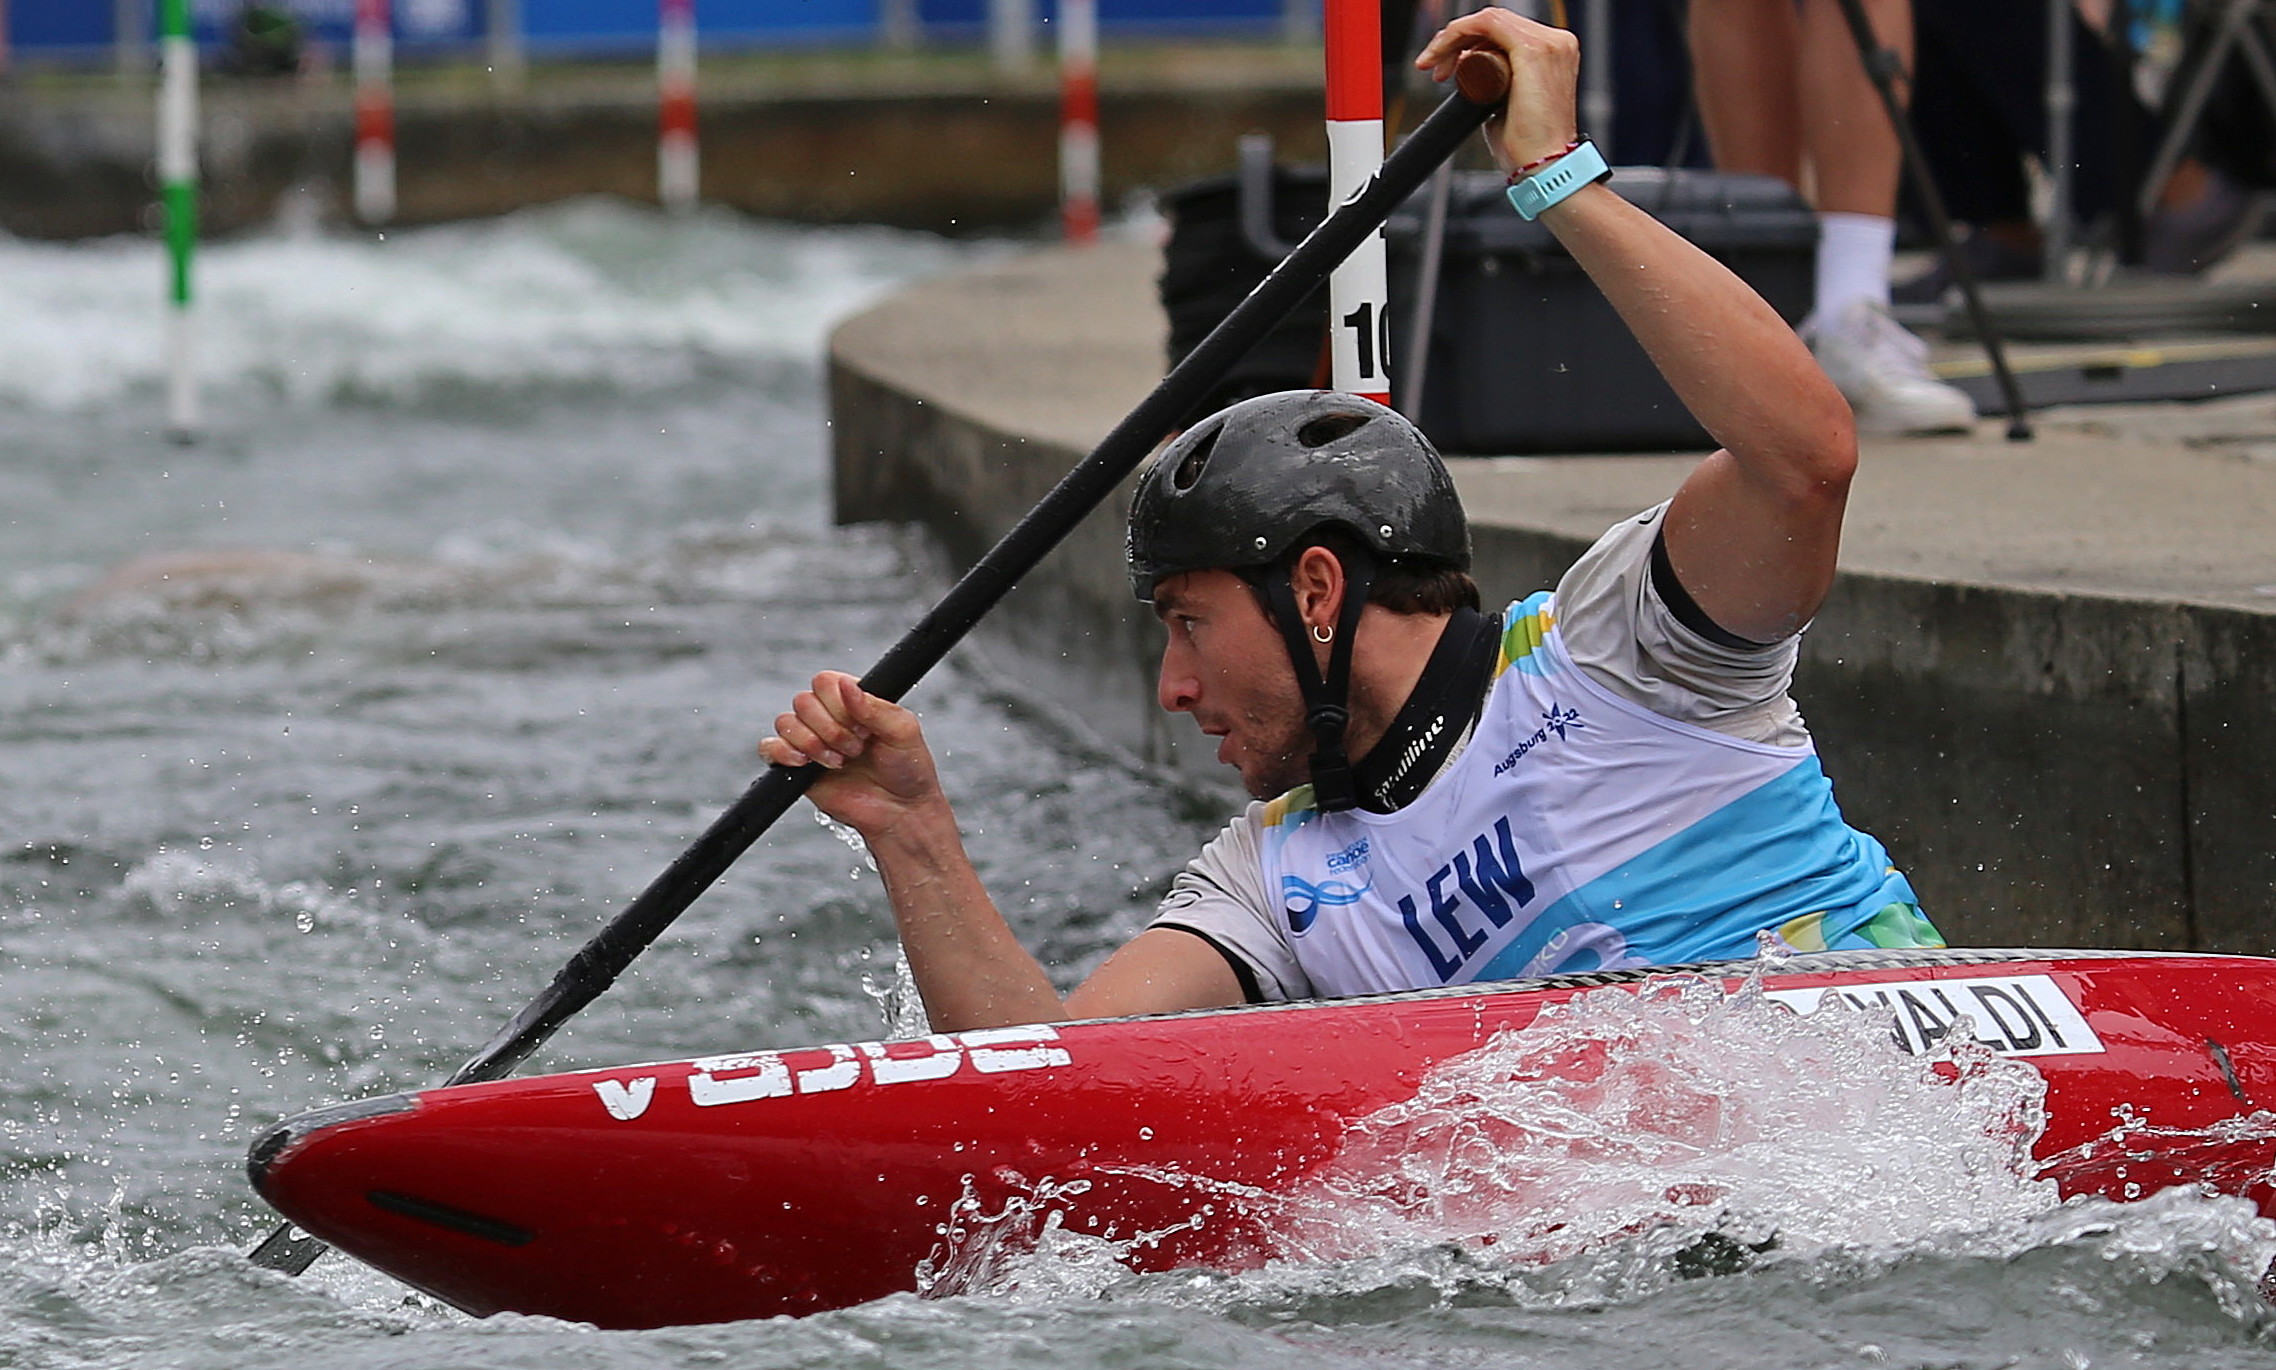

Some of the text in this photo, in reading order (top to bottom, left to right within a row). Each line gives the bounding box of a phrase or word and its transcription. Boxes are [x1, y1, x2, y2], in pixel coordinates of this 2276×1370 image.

[1494, 728, 1548, 778] Augsburg
[1327, 843, 1369, 868] canoe
[1397, 814, 1536, 984] LEW
